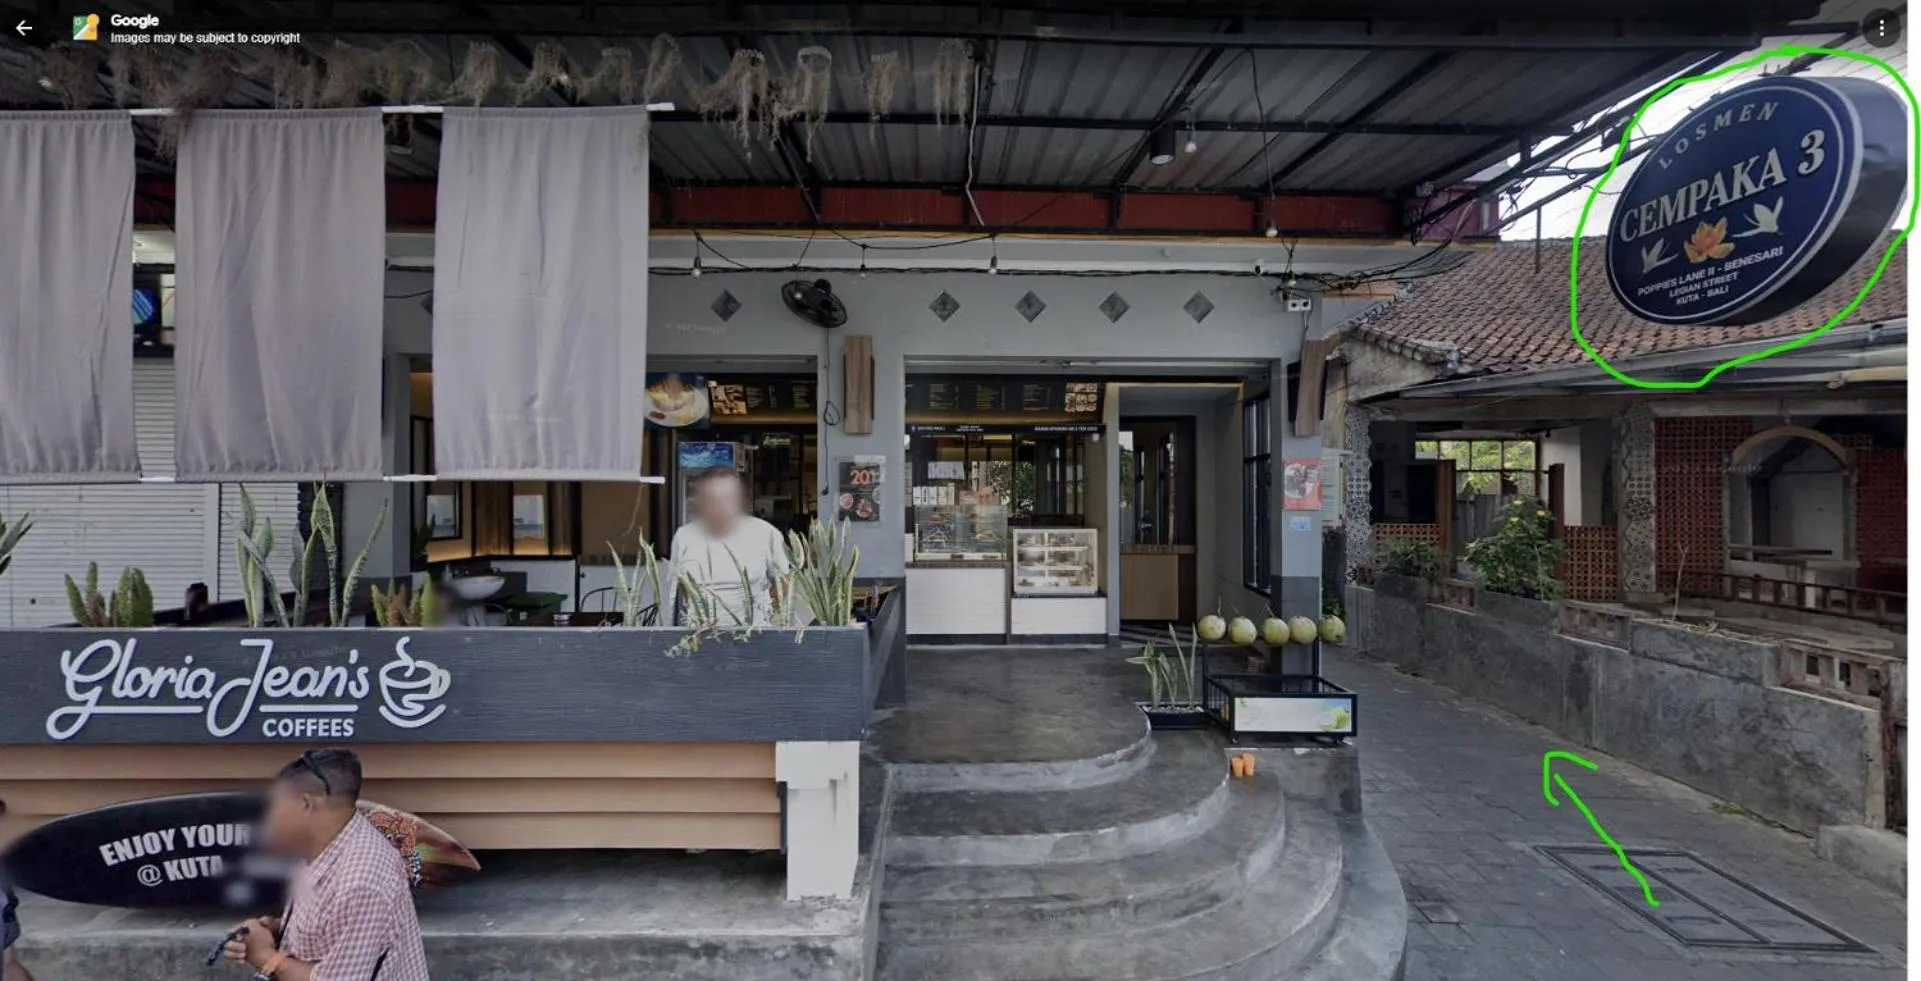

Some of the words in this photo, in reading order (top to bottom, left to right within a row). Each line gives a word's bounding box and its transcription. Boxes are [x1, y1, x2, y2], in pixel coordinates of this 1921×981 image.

[1659, 102, 1778, 170] LOSMEN
[1620, 147, 1788, 242] CEMPAKA
[1798, 129, 1825, 174] 3
[1638, 278, 1677, 297] POPPIES
[1679, 269, 1707, 285] LANE
[1707, 266, 1716, 276] II
[1725, 246, 1784, 270] BENESARI
[1669, 281, 1701, 298] LEGIAN
[1703, 272, 1739, 287] STREET
[1677, 293, 1700, 305] KUTA
[1707, 286, 1728, 297] BALI
[45, 637, 217, 741] Gloria
[206, 638, 370, 737] Jean's
[263, 717, 355, 738] COFFEES
[98, 828, 176, 867] ENJOY
[180, 823, 251, 848] YOUR
[137, 864, 163, 887] @
[163, 855, 225, 882] KUTA
